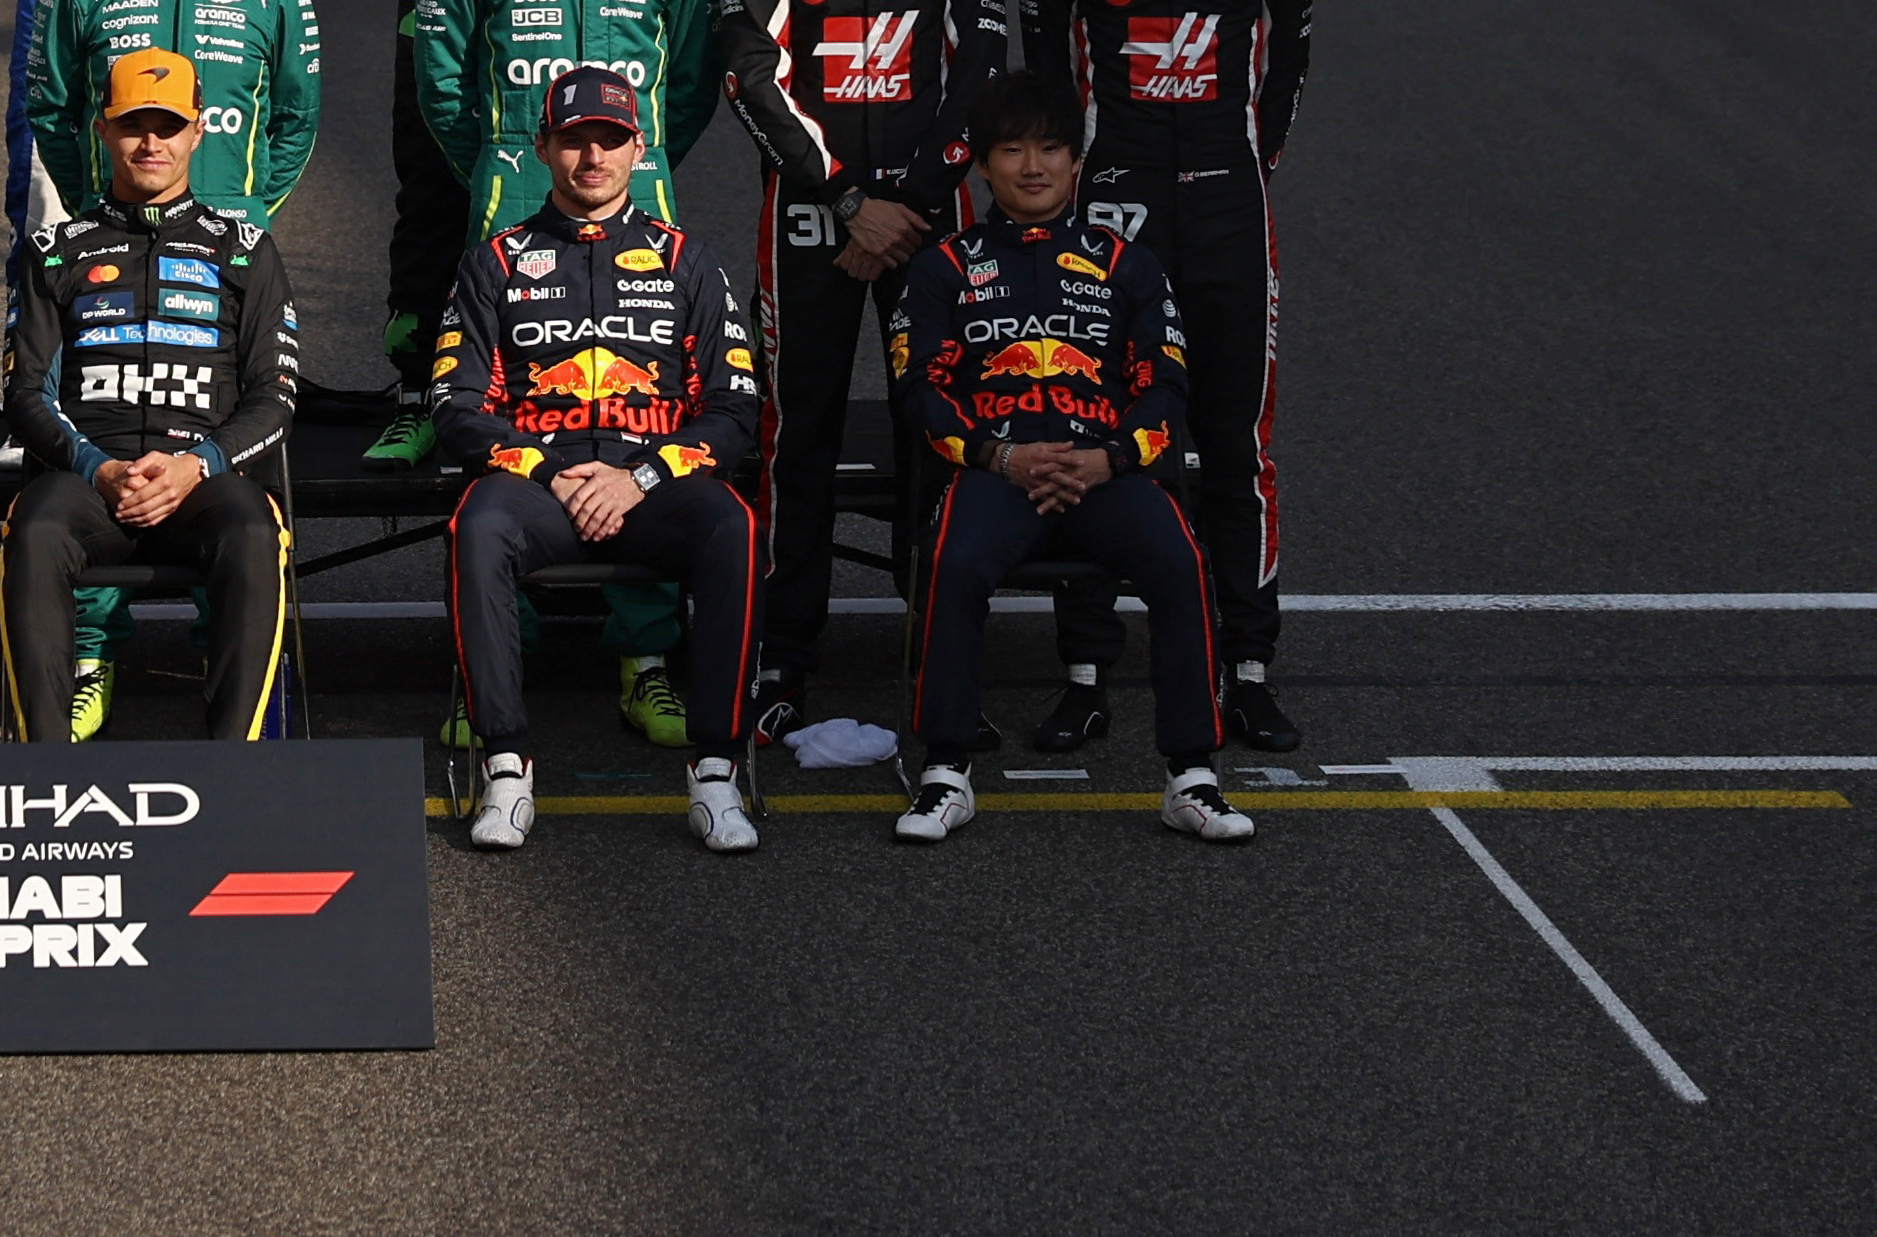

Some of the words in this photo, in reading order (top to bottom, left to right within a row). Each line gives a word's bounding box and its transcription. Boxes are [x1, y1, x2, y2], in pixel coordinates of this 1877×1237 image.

[194, 8, 246, 23] aramco
[515, 11, 561, 23] JCB
[599, 5, 644, 20] CoreWeave
[101, 13, 159, 31] cognizant
[109, 33, 151, 49] BOSS
[209, 36, 244, 49] Valvoline
[512, 31, 563, 42] SentinelOne
[194, 49, 244, 64] CoreWeave
[507, 57, 646, 88] araco
[562, 83, 578, 105] 1
[824, 73, 911, 98] HAAS
[1131, 73, 1218, 98] HAAS
[733, 98, 784, 166] MoneyGram
[631, 161, 658, 171] STROLL
[216, 208, 247, 219] ALONSO
[77, 243, 130, 260] Android
[521, 251, 554, 261] TAG
[174, 270, 203, 283] CISCO
[506, 286, 550, 303] Mobil
[82, 310, 95, 319] DP
[96, 307, 126, 318] WORLD
[164, 295, 214, 315] allwyn
[618, 299, 675, 310] HONDA
[1062, 297, 1112, 317] HONDA
[122, 326, 213, 345] Technologies
[511, 315, 674, 346] ORACLE
[963, 314, 1111, 347] ORACLE
[80, 362, 212, 409] OKX
[972, 384, 1044, 419] Red
[1048, 385, 1119, 429] Bull
[516, 399, 592, 434] Red
[597, 398, 683, 435] Bull
[231, 440, 265, 465] RICHARD
[264, 427, 284, 449] MILLE
[21, 842, 134, 861] AIRWAYS
